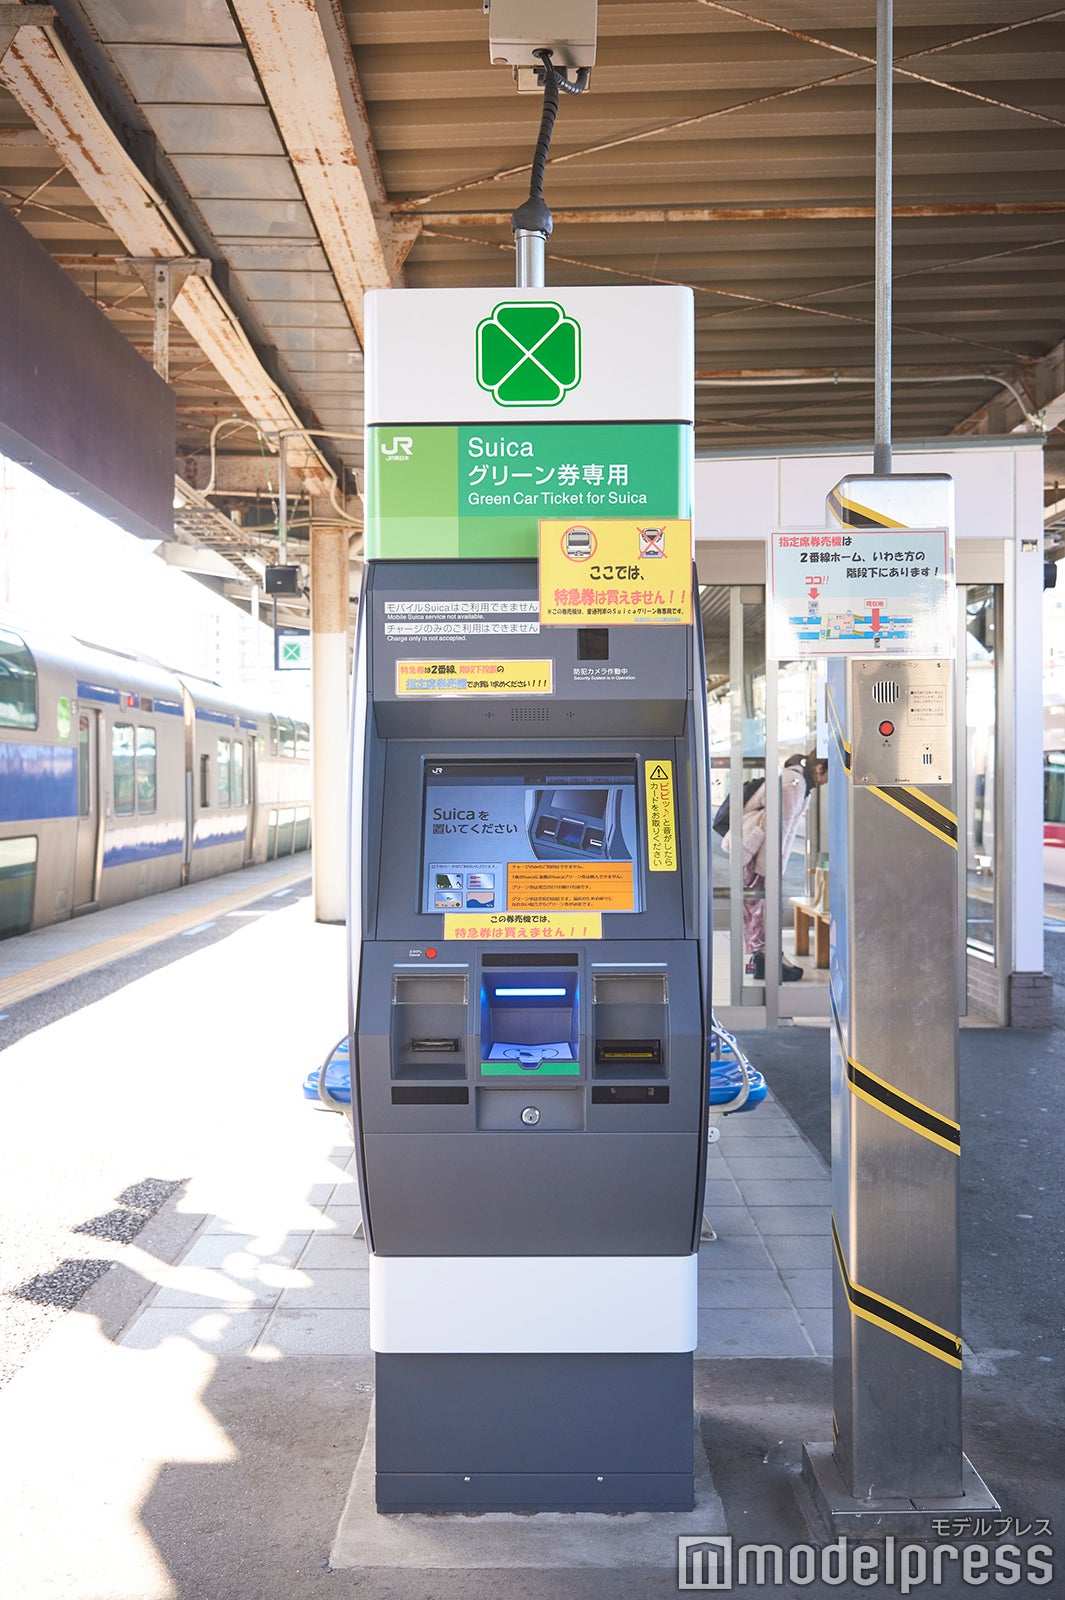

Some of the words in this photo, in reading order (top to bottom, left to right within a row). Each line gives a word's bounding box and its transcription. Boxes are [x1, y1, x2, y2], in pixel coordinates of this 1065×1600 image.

[381, 437, 413, 455] JR
[468, 436, 534, 458] Suica
[468, 463, 629, 487] グリーン券専用
[468, 491, 511, 505] Green
[513, 491, 539, 505] Car
[541, 491, 583, 505] Ticket
[586, 491, 605, 505] for
[608, 491, 648, 505] Suica
[779, 536, 852, 548] 指定席券売機は
[800, 550, 925, 563] 2番線ホーム、いわき方の
[589, 565, 645, 580] ここでは、
[846, 566, 939, 579] 階段下にあります!
[805, 576, 829, 585] ココ!!
[554, 588, 687, 606] 特急券は買えません！！
[387, 602, 538, 612] モバイルSuicaはご利用できません
[387, 623, 538, 634] チャージのみのご利用はできません
[573, 667, 628, 675] 防犯カメラ作動中
[433, 823, 518, 835] 置いてください
[650, 783, 662, 867] カードをお取りください
[490, 915, 551, 924] この券売機では、
[454, 927, 588, 939] 特急券は買えません！！
